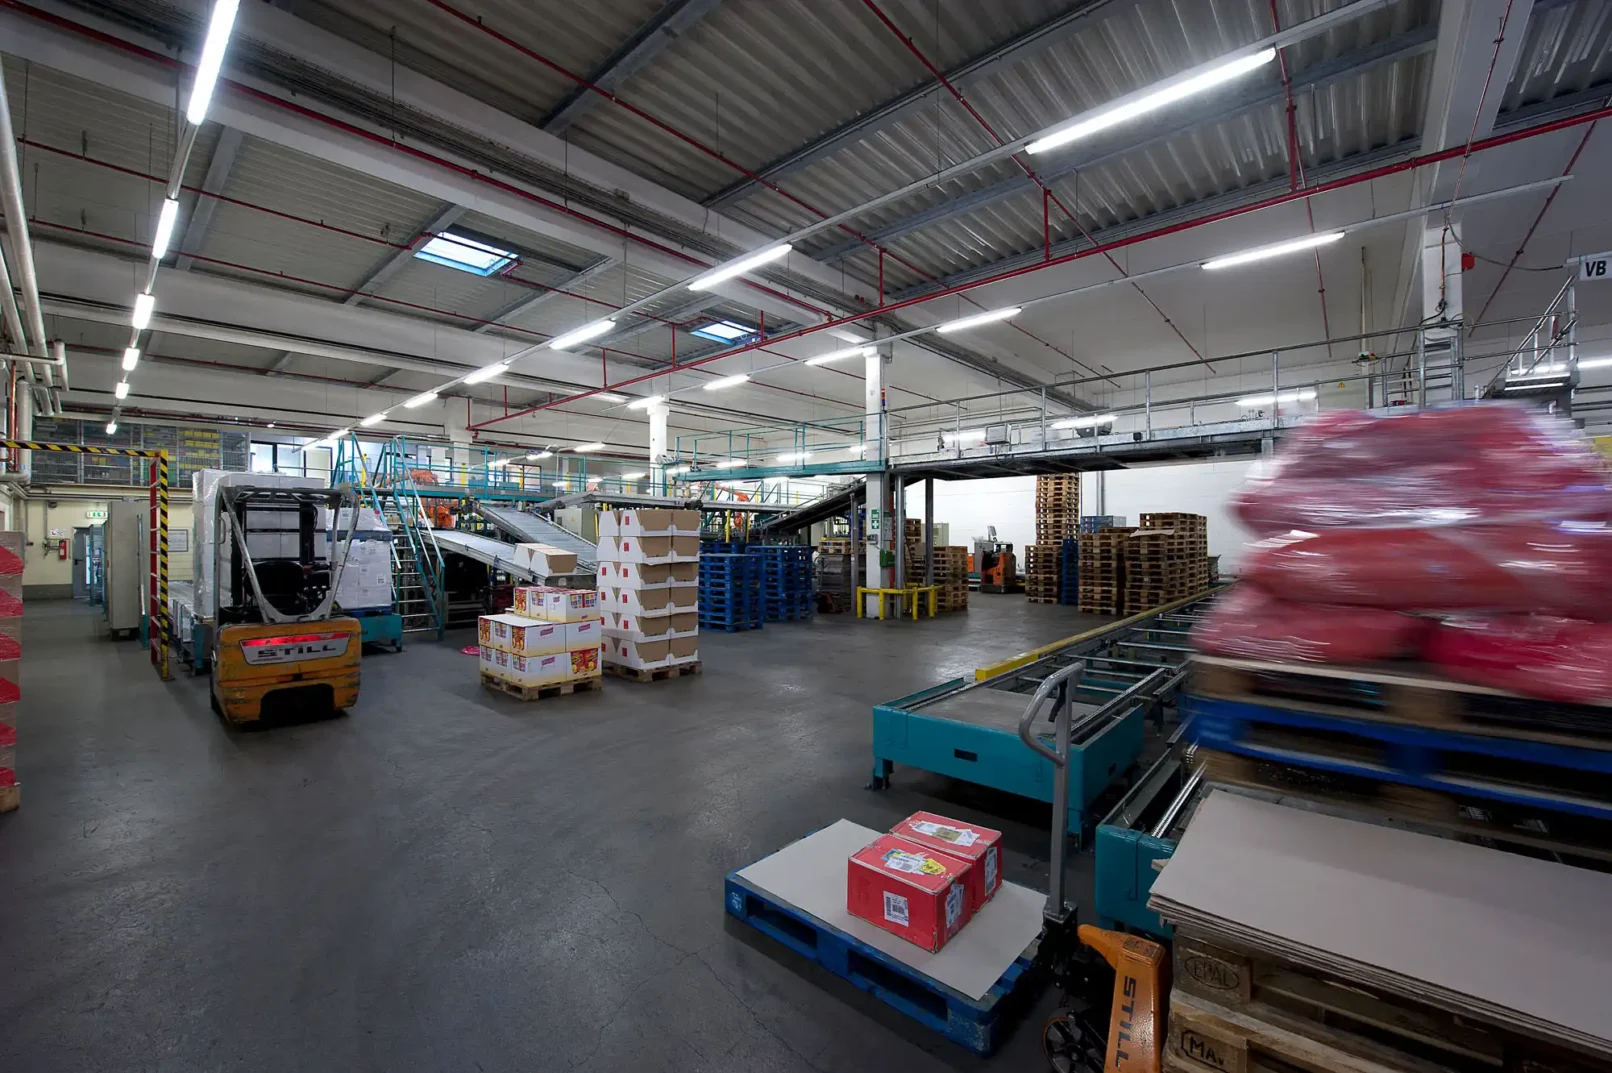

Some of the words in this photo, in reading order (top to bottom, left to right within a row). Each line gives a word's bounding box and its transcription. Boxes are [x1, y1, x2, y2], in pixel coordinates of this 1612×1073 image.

[1585, 260, 1607, 277] VB
[258, 644, 336, 658] STILL
[1194, 959, 1231, 987] EPAL
[1115, 975, 1136, 1068] STILL
